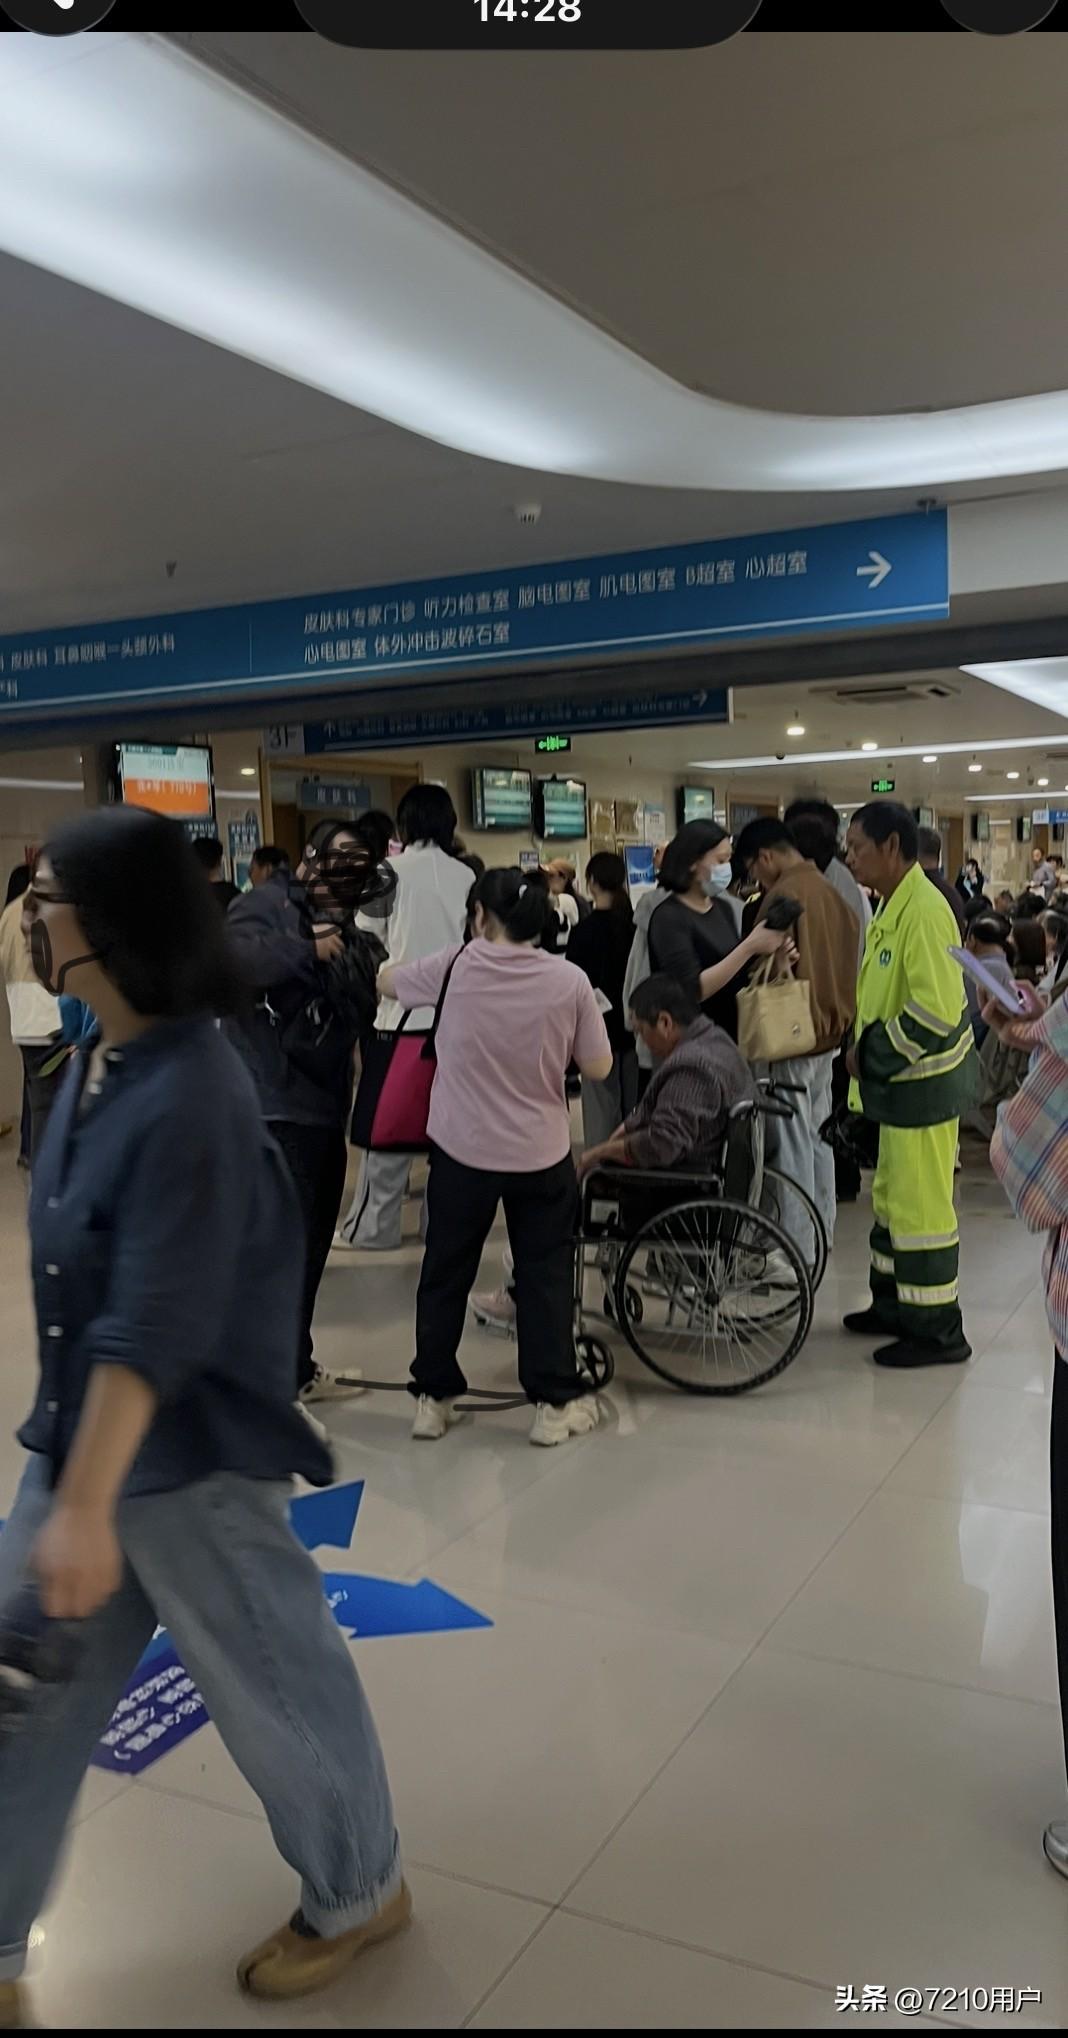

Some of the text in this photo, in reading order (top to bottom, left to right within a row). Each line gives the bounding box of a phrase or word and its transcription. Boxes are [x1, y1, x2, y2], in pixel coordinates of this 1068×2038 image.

[303, 549, 808, 635] 皮肤科专家门诊 听力检查室 脑电图室 肌电图室 B超室 心超室
[303, 621, 510, 665] 心电图室 体外冲击波碎石室
